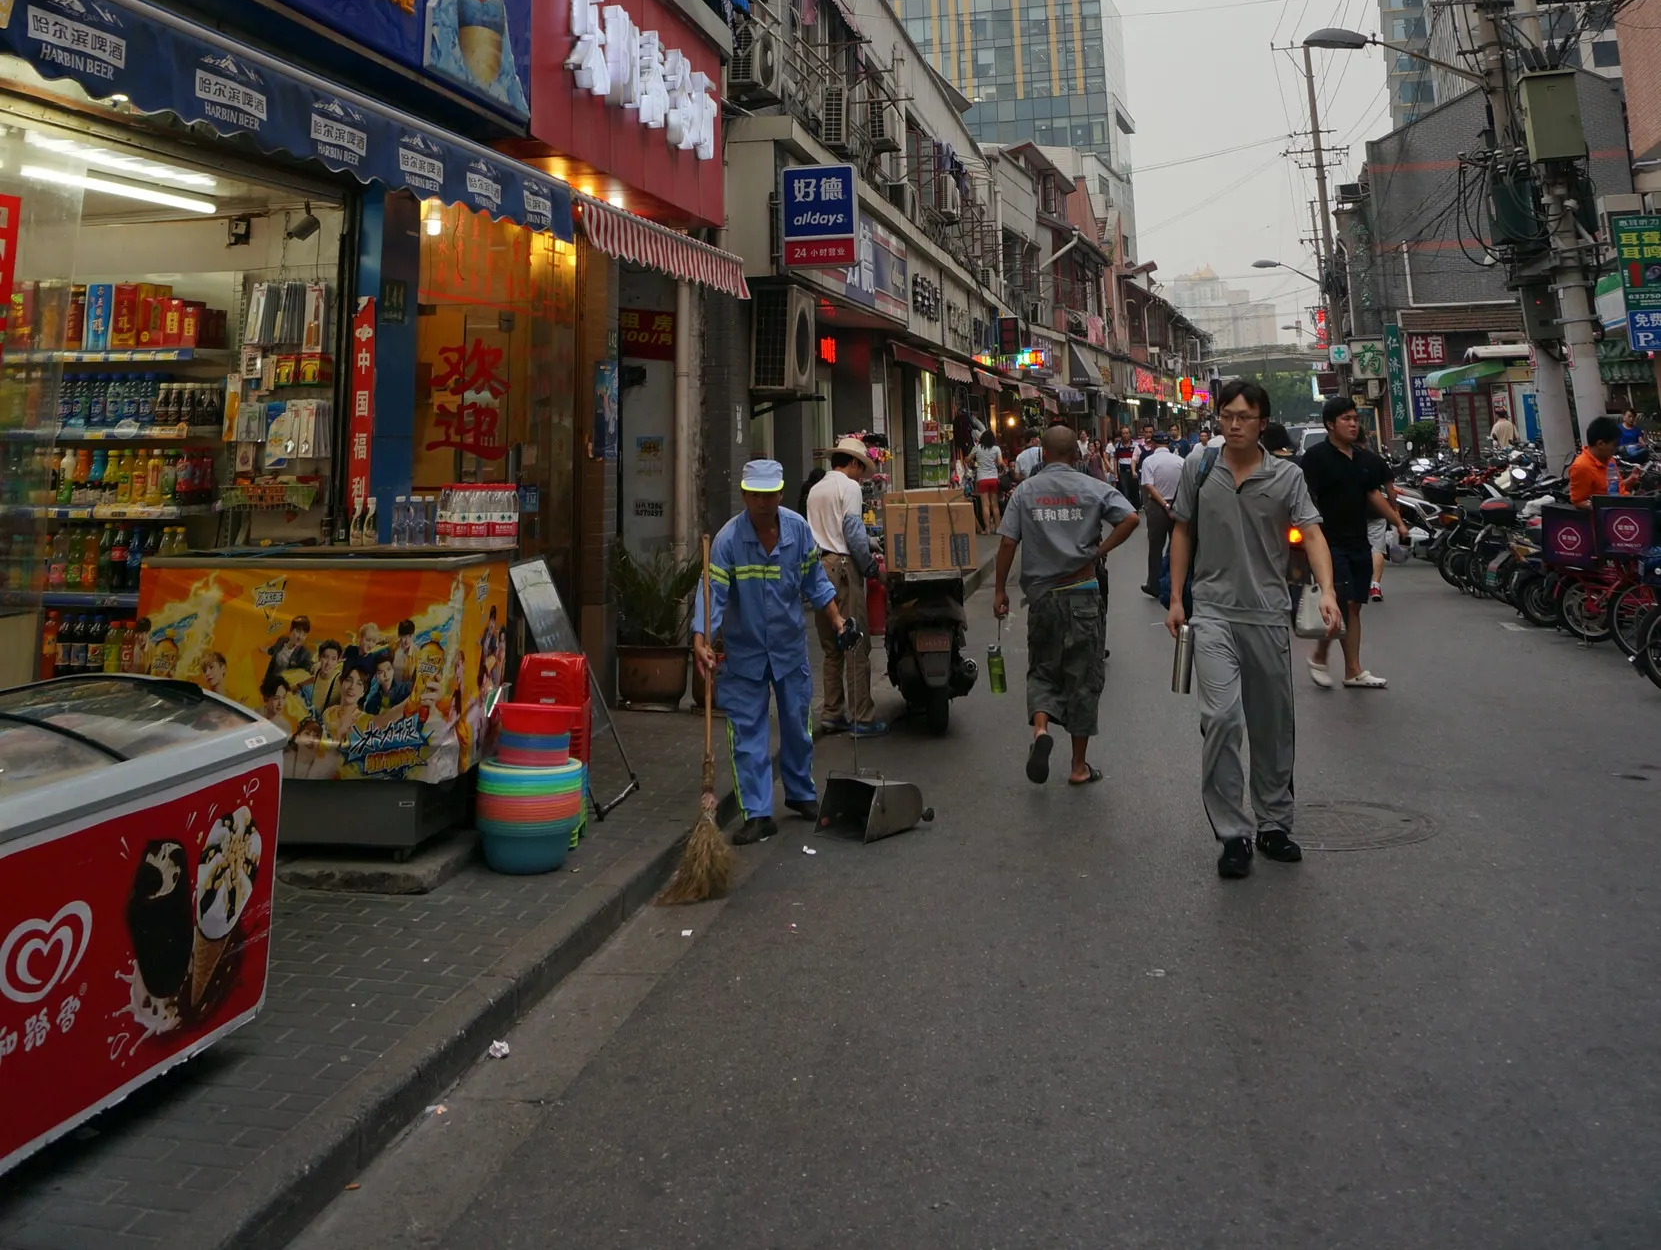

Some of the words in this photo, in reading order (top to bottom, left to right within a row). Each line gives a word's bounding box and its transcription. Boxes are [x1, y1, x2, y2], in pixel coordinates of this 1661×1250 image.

[32, 14, 123, 62] 哈尔滨啤酒
[40, 42, 85, 71] HARBIN
[86, 58, 114, 80] BEER
[198, 76, 265, 115] 哈尔滨啤酒
[204, 101, 238, 124] HARBIN
[238, 115, 261, 131] BEER
[313, 120, 366, 151] 哈尔滨啤酒
[317, 141, 343, 162] HARBIN
[344, 151, 359, 166] BEER
[400, 153, 443, 178] 哈尔滨啤酒
[793, 177, 843, 202] 好德
[793, 211, 844, 226] alldays
[794, 247, 807, 259] 24
[810, 247, 846, 258] 小时营业
[1410, 335, 1444, 359] 住宿
[1637, 332, 1654, 347] P
[1353, 343, 1384, 376] 药
[1386, 335, 1408, 422] 仁济药房
[426, 338, 511, 460] 欢迎
[353, 348, 371, 500] 中国福利
